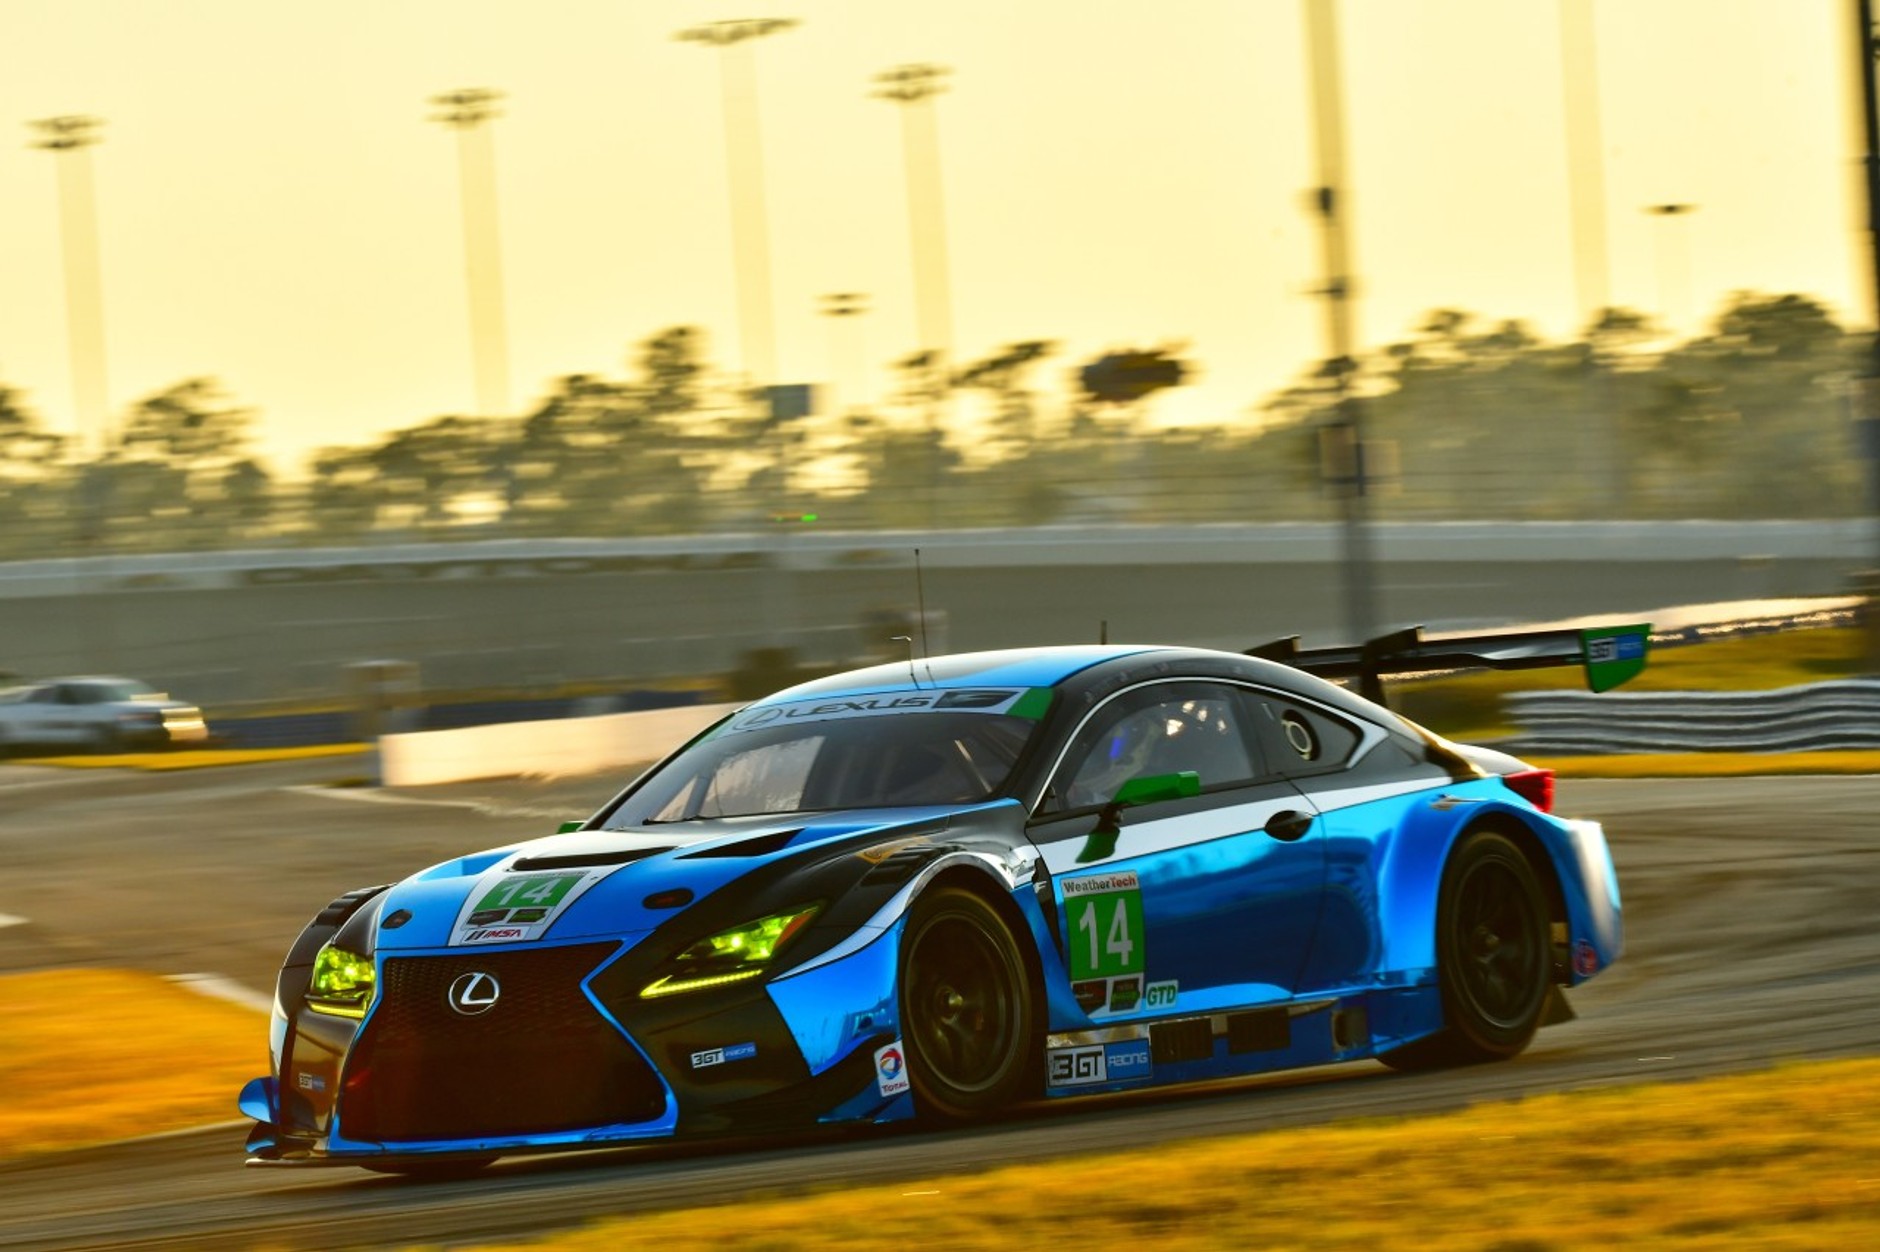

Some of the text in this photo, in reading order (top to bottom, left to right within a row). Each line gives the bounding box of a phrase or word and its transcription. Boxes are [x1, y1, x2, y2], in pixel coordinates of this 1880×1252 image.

[785, 697, 932, 717] LEXUS
[497, 877, 562, 906] 14
[1063, 875, 1137, 893] WeatherTech
[1080, 898, 1133, 970] 14
[1147, 984, 1177, 1006] GTD
[693, 1050, 722, 1065] 3GT
[1052, 1050, 1103, 1080] 3GT
[881, 1080, 909, 1093] TOTAL
